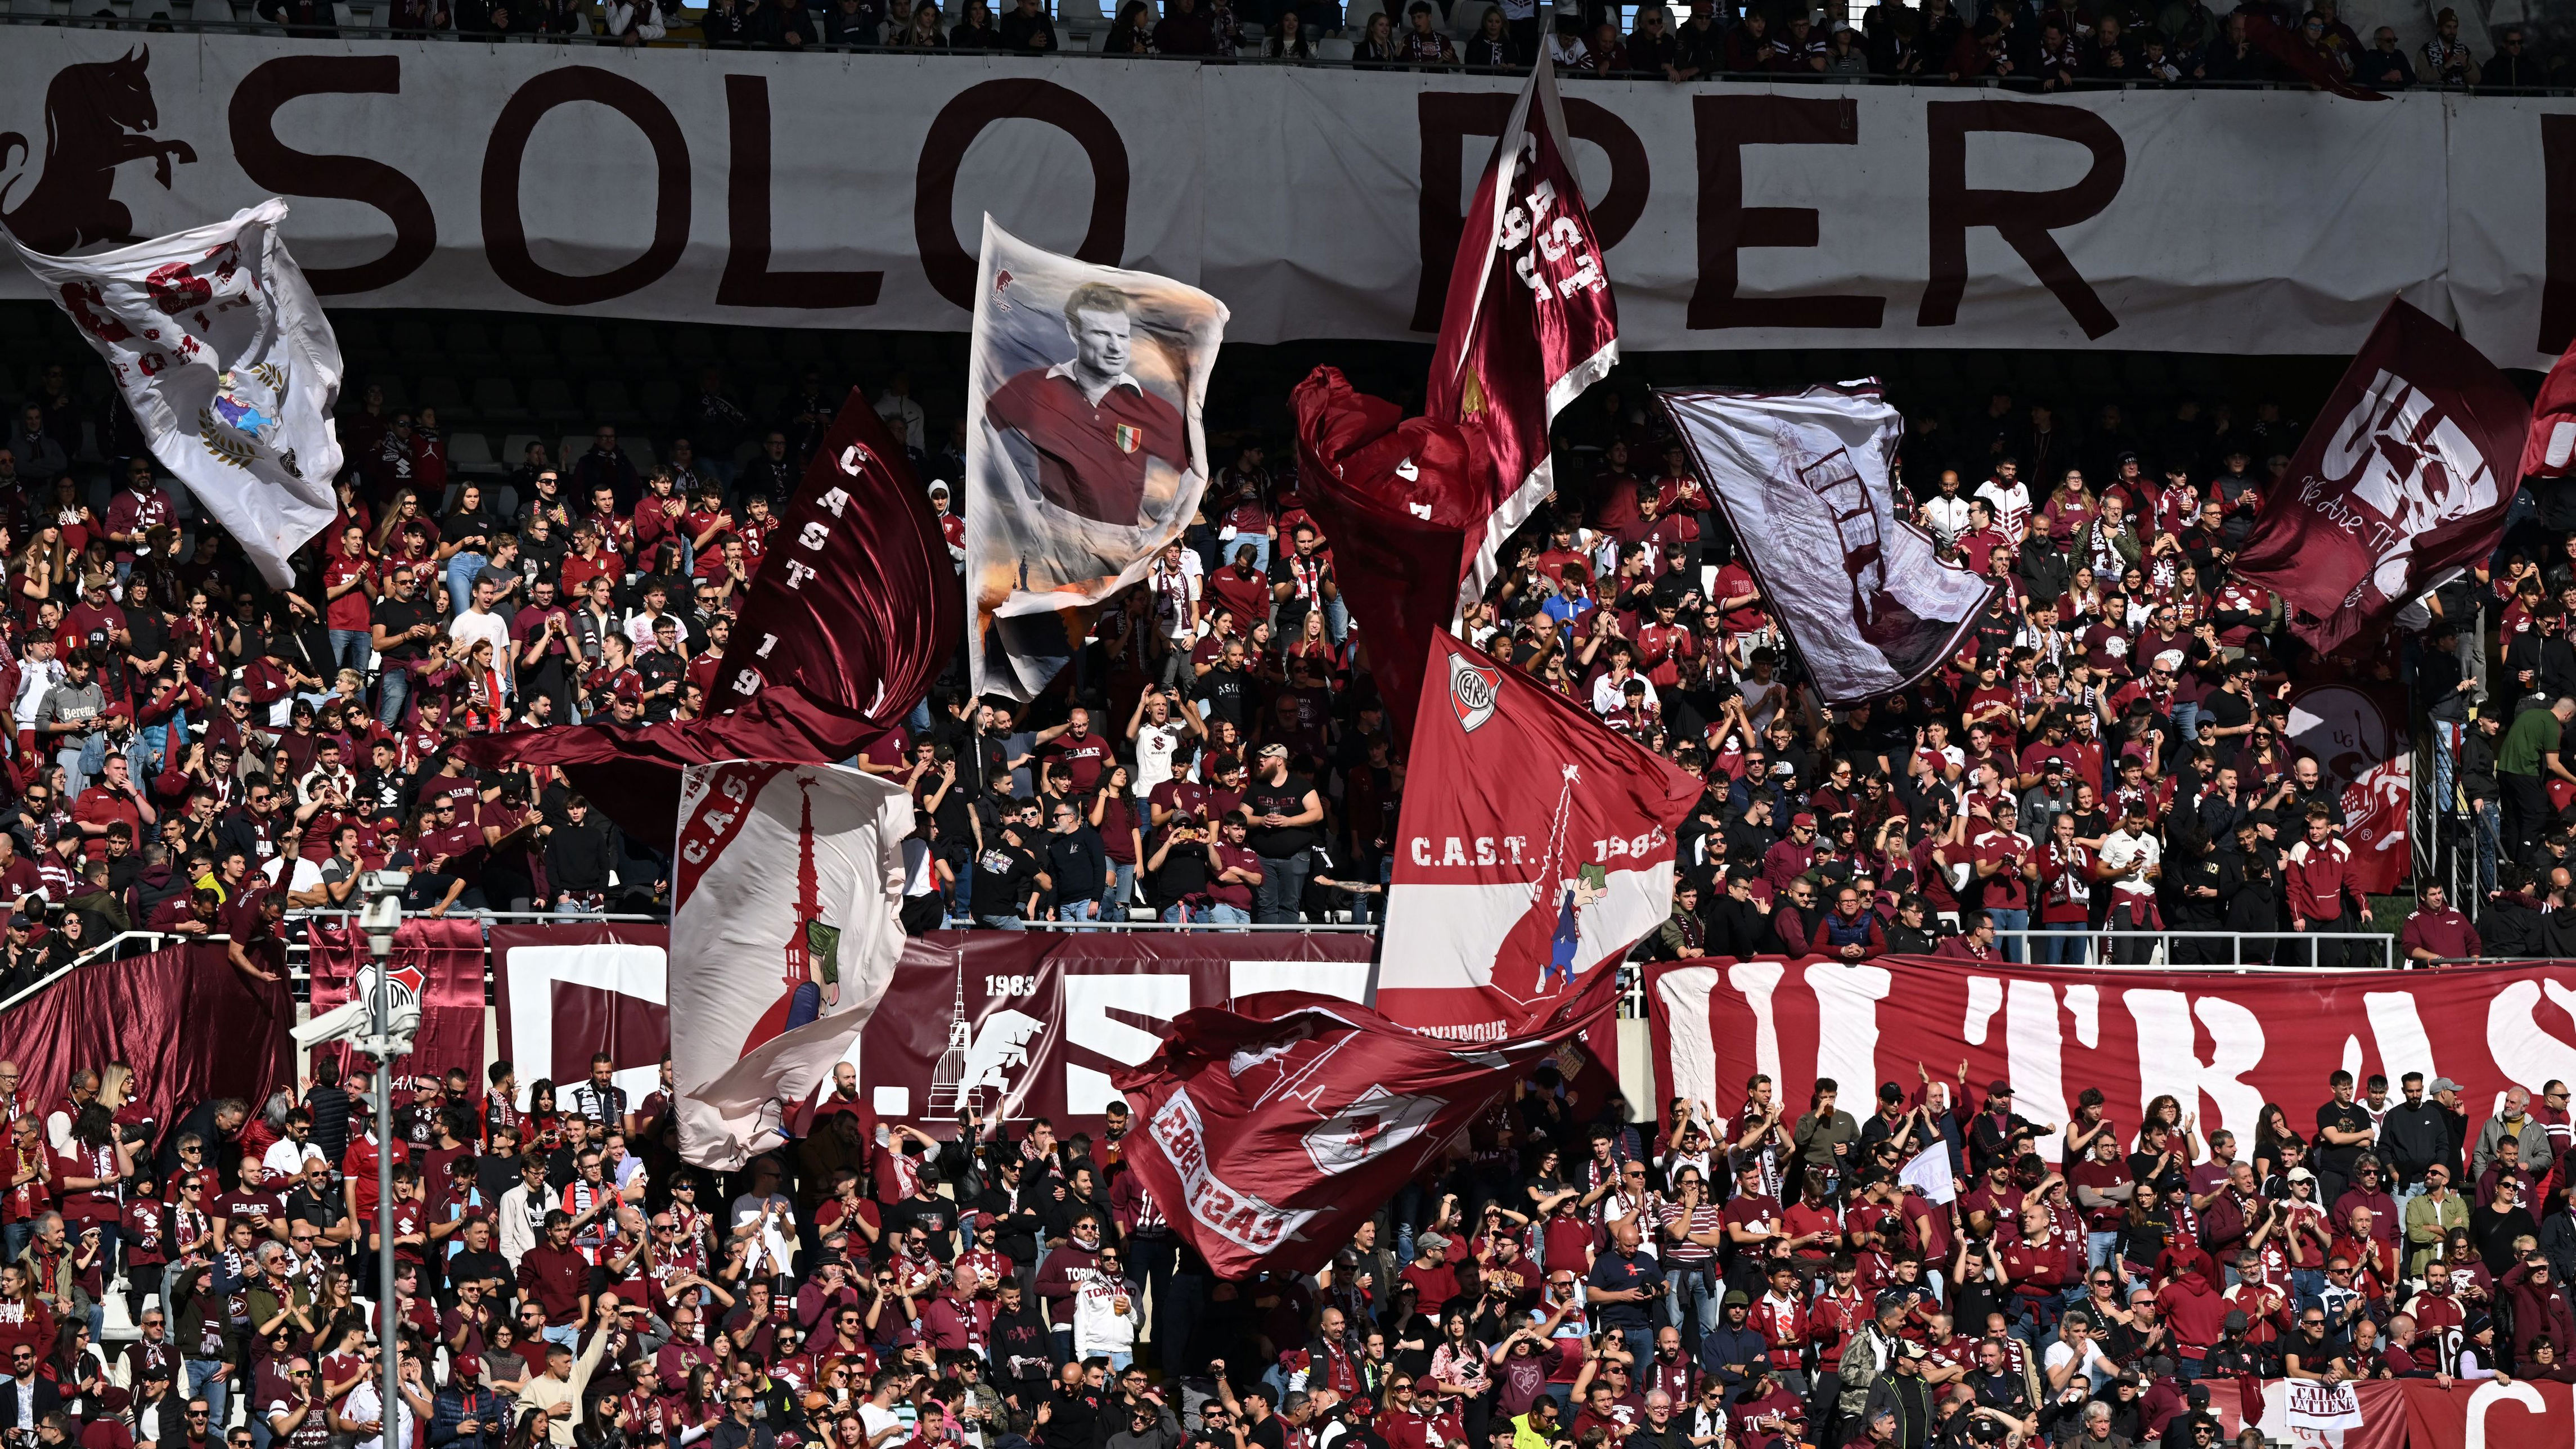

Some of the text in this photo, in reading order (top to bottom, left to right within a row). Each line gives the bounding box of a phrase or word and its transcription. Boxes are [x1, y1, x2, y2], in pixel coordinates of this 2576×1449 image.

[228, 55, 2126, 341] SOLO PER
[231, 397, 248, 408] CAST
[785, 444, 869, 591] CAST
[2298, 475, 2395, 554] We Are Th
[91, 633, 104, 641] ICON
[62, 706, 97, 721] Beretta
[2333, 730, 2353, 748] UG
[1411, 836, 1535, 866] C.A.S.T.
[985, 975, 1036, 997] 1983
[531, 1218, 546, 1227] adid
[1064, 1267, 1096, 1282] TORIN
[2296, 1387, 2345, 1401] CAIRO
[2289, 1396, 2353, 1412] VATTENE
